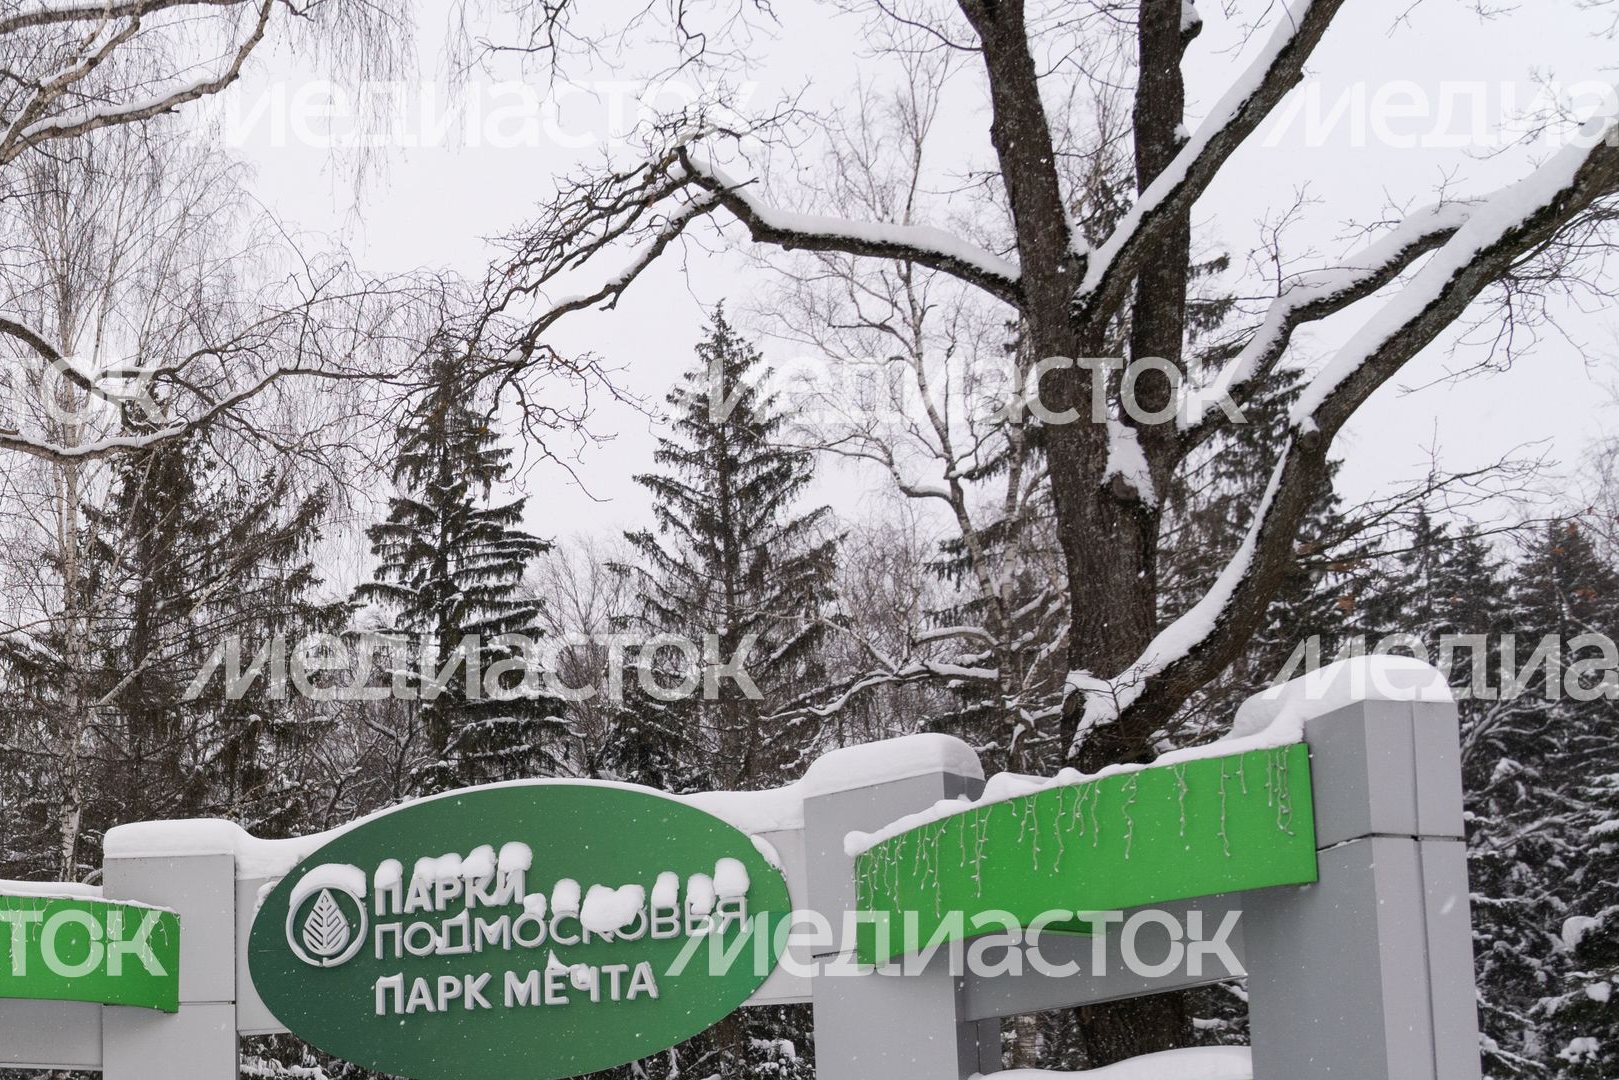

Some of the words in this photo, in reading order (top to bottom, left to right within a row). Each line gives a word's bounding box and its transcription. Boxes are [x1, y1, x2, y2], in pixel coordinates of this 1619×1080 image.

[375, 866, 526, 916] ПАРКИ
[375, 972, 492, 1015] ПАРК
[504, 961, 659, 1008] МЕЧТА
